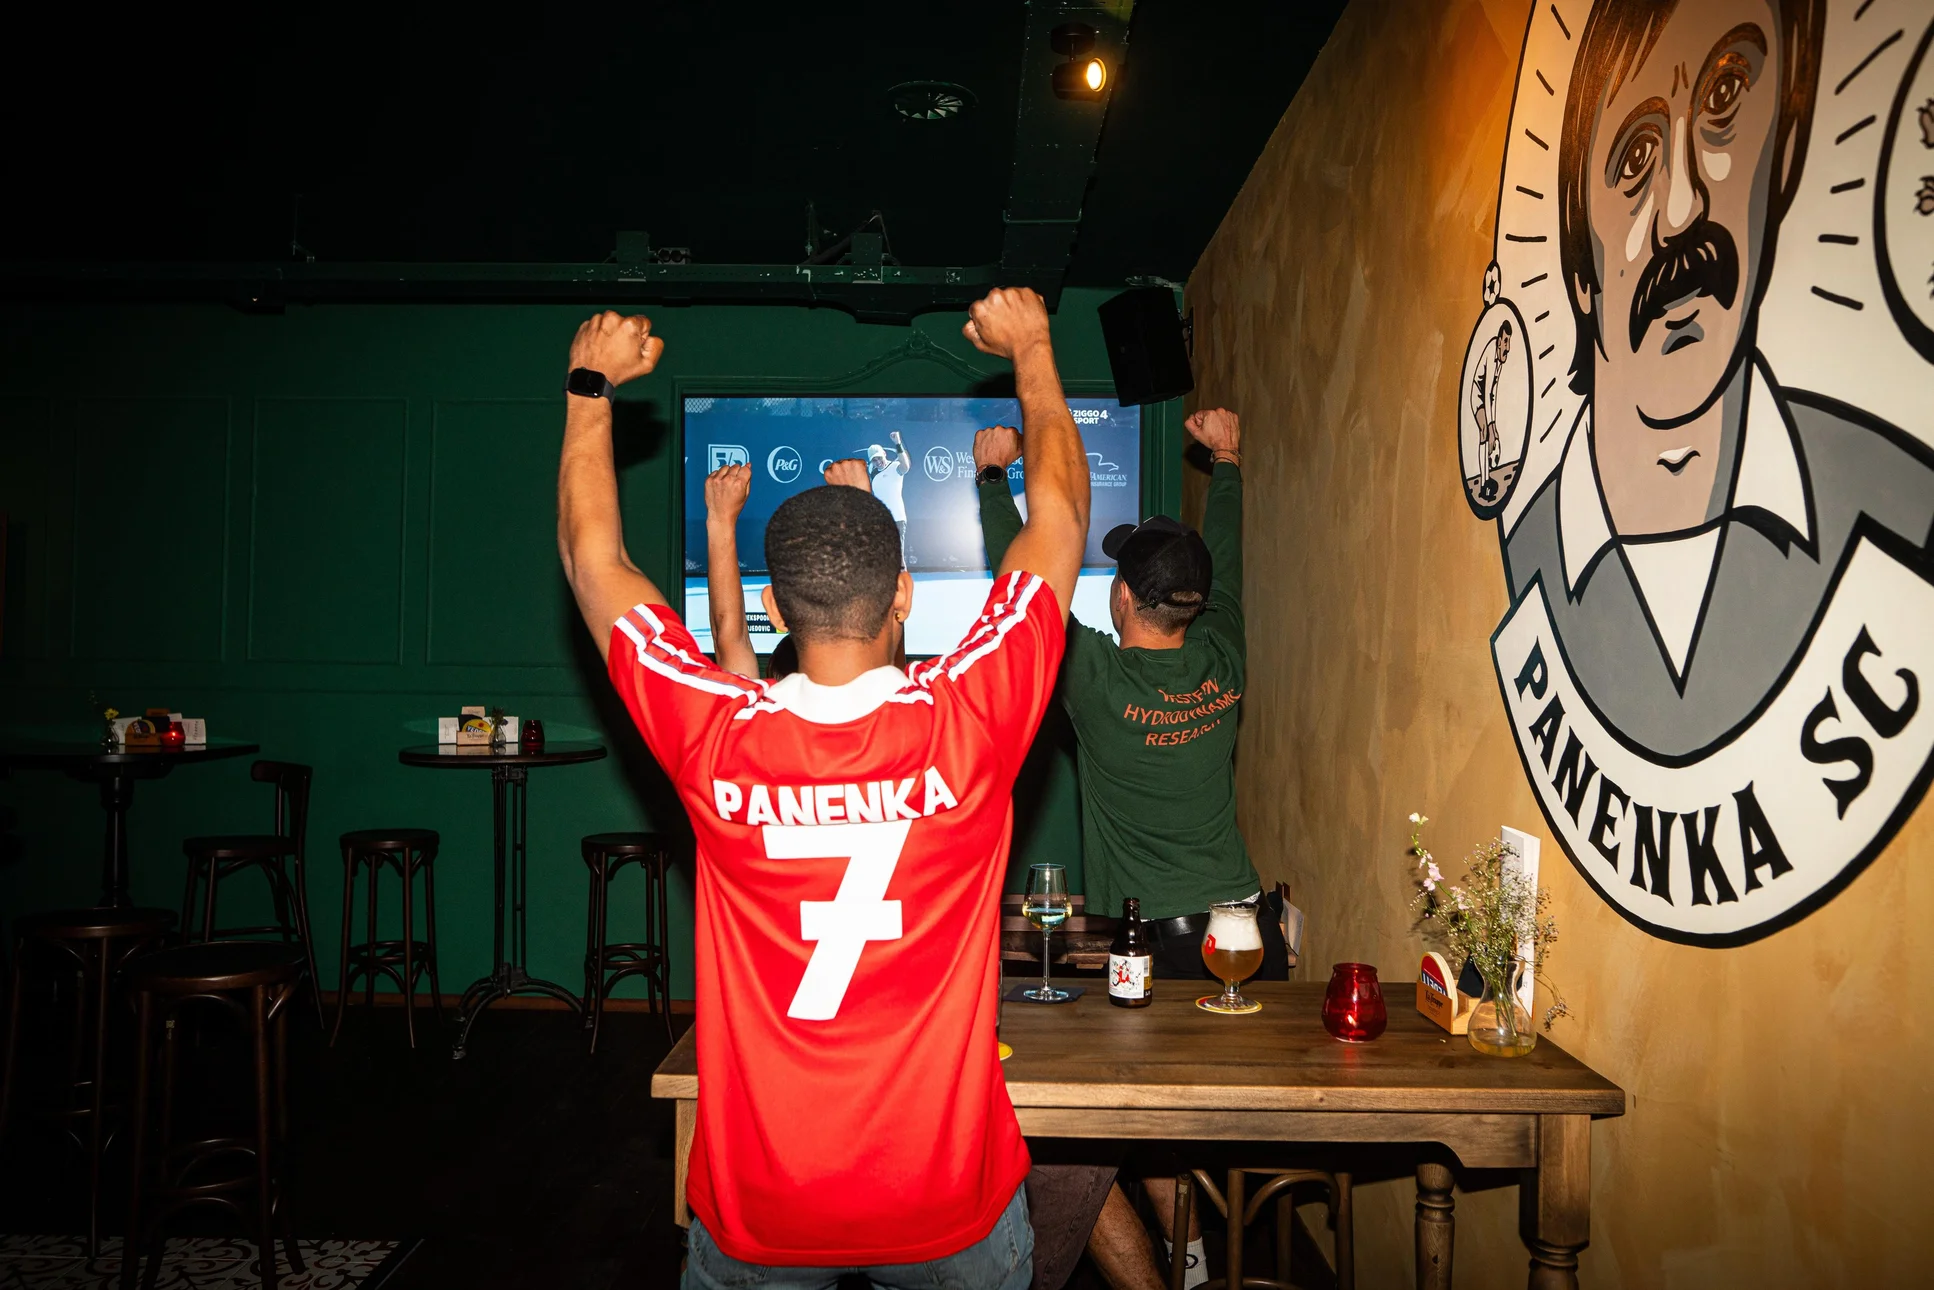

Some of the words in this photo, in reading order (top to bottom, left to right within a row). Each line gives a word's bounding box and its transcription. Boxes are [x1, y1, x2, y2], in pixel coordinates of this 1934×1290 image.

[1073, 409, 1100, 418] ZIGGO
[1100, 409, 1109, 420] 4
[1073, 417, 1100, 425] SPORT
[775, 458, 799, 471] P&G
[926, 455, 951, 475] W&S
[1513, 635, 1794, 907] PANENKA
[1800, 623, 1921, 821] SC
[713, 765, 958, 826] PANENKA
[762, 819, 912, 1021] 7
